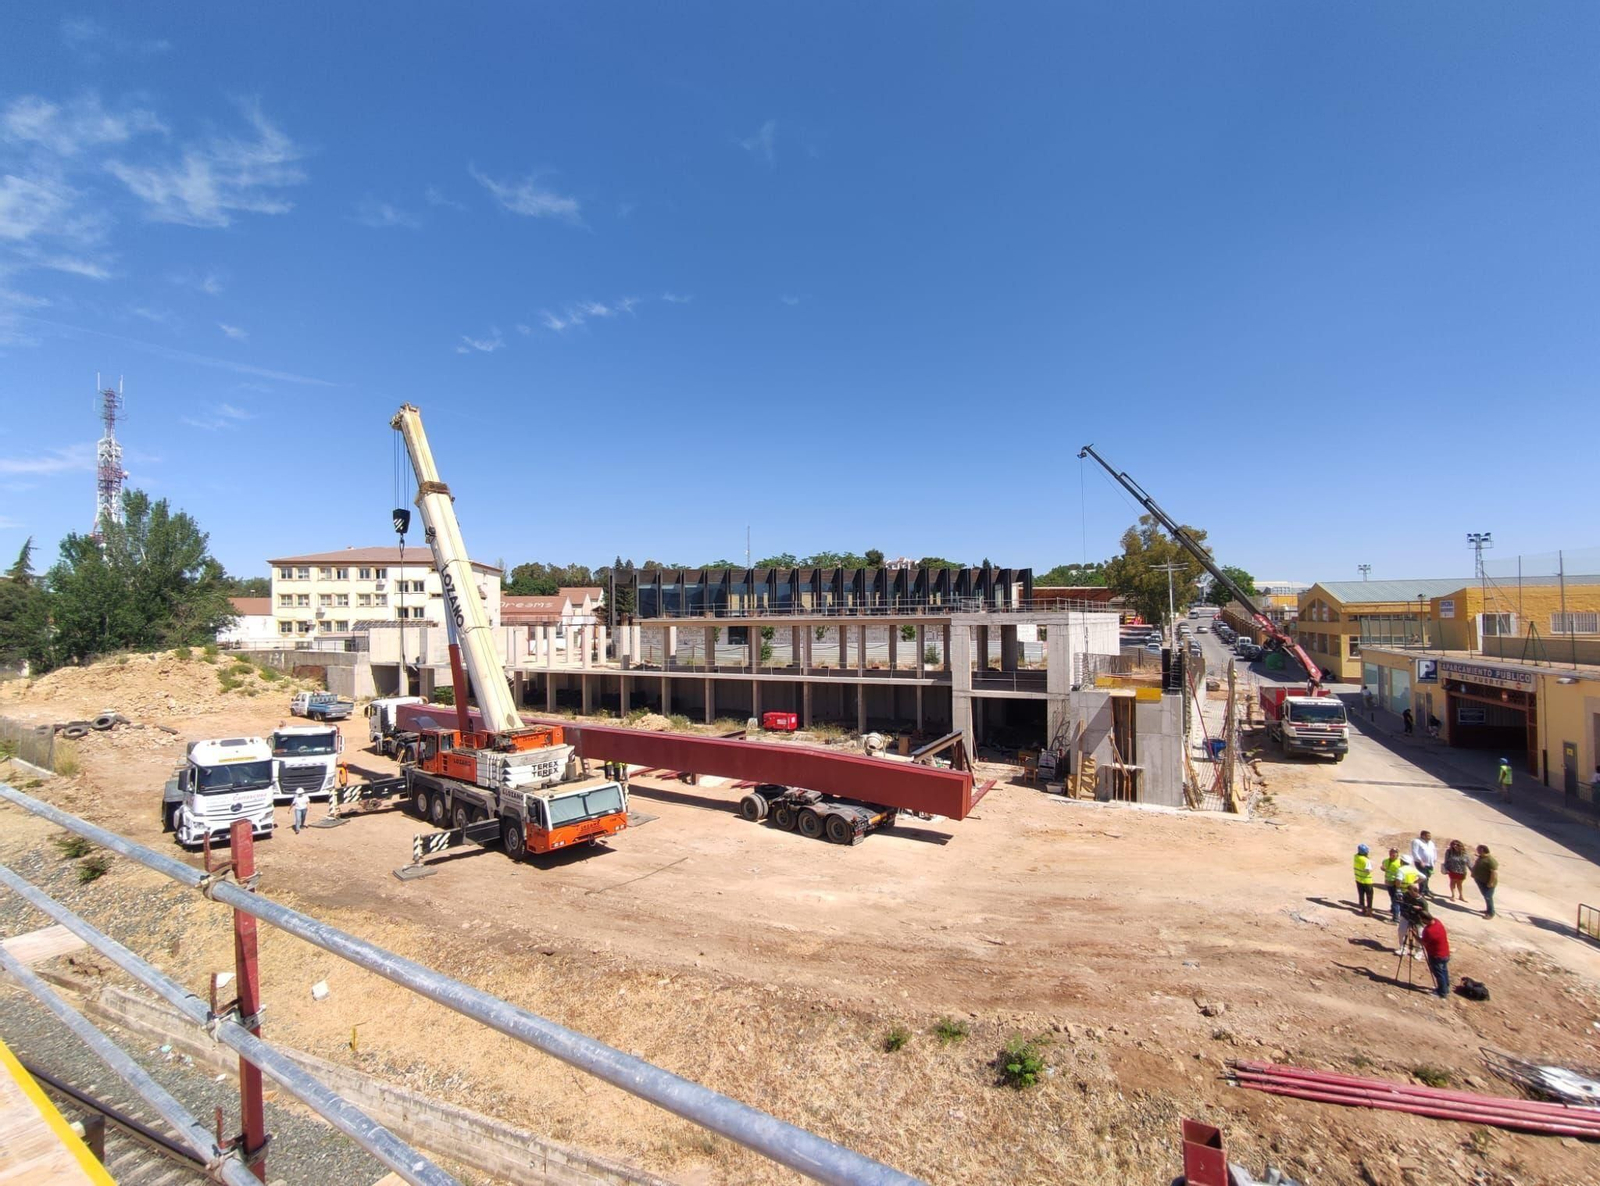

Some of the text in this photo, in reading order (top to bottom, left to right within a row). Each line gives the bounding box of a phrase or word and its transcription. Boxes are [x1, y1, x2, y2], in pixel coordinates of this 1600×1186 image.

[441, 564, 464, 628] LOZANO
[1420, 661, 1435, 678] P
[1442, 662, 1493, 677] APARCAMIENTO
[454, 758, 471, 766] LOZANO
[531, 761, 558, 771] TEREX
[531, 768, 558, 778] TEREX
